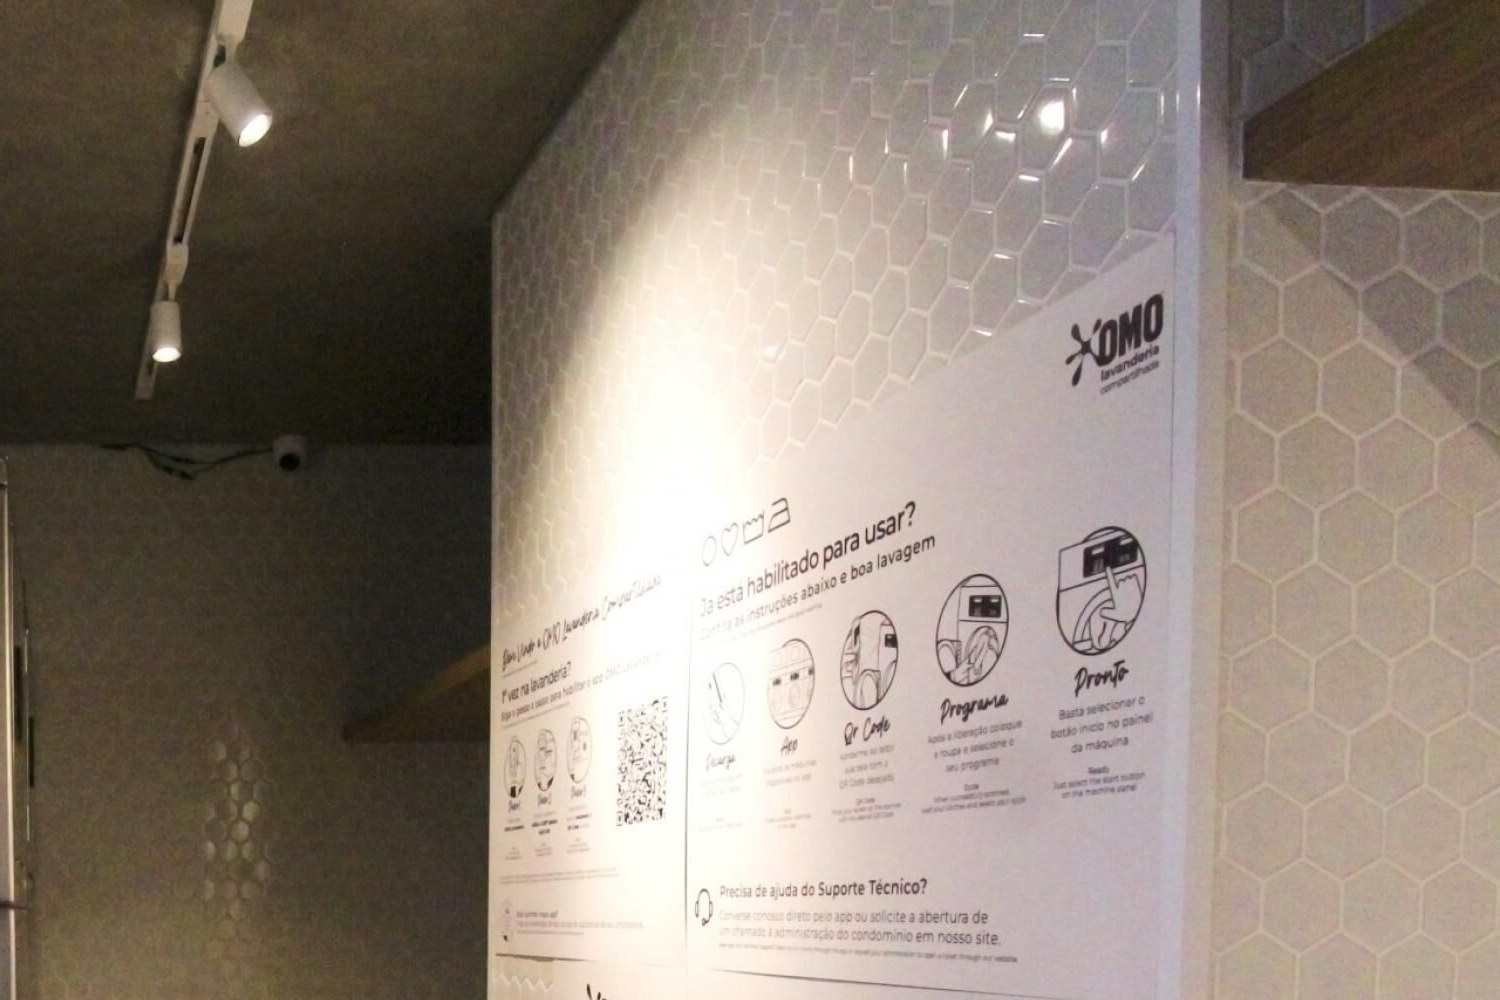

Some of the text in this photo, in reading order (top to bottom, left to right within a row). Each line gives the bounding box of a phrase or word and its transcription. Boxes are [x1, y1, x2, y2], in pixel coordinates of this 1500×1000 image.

[1099, 294, 1164, 367] OMO
[1101, 345, 1160, 382] lavanderia
[747, 550, 819, 598] habilitado
[823, 532, 859, 570] para
[865, 500, 916, 545] usar?
[747, 591, 798, 622] instruções
[801, 575, 837, 600] abaixo
[840, 571, 847, 584] e
[851, 560, 873, 580] boa
[877, 535, 936, 570] lavagem
[531, 661, 571, 692] lavanderia?
[1074, 659, 1129, 698] Pronto
[940, 693, 1010, 725] Programa
[1059, 696, 1145, 720] Basta selecionar o
[1122, 712, 1154, 728] painel
[863, 715, 891, 741] Code
[1071, 735, 1129, 754] da máquina
[720, 878, 928, 901] Precisa de ajuda do Suporte Técnico?
[834, 912, 853, 926] app
[856, 913, 868, 923] ou
[870, 909, 907, 924] solicite
[909, 913, 916, 923] a
[919, 909, 969, 925] abertura
[971, 909, 989, 925] de
[837, 927, 850, 941] do
[851, 928, 913, 943] condomínio
[916, 932, 934, 943] em
[937, 932, 972, 945] nosso
[975, 930, 1001, 946] site.
